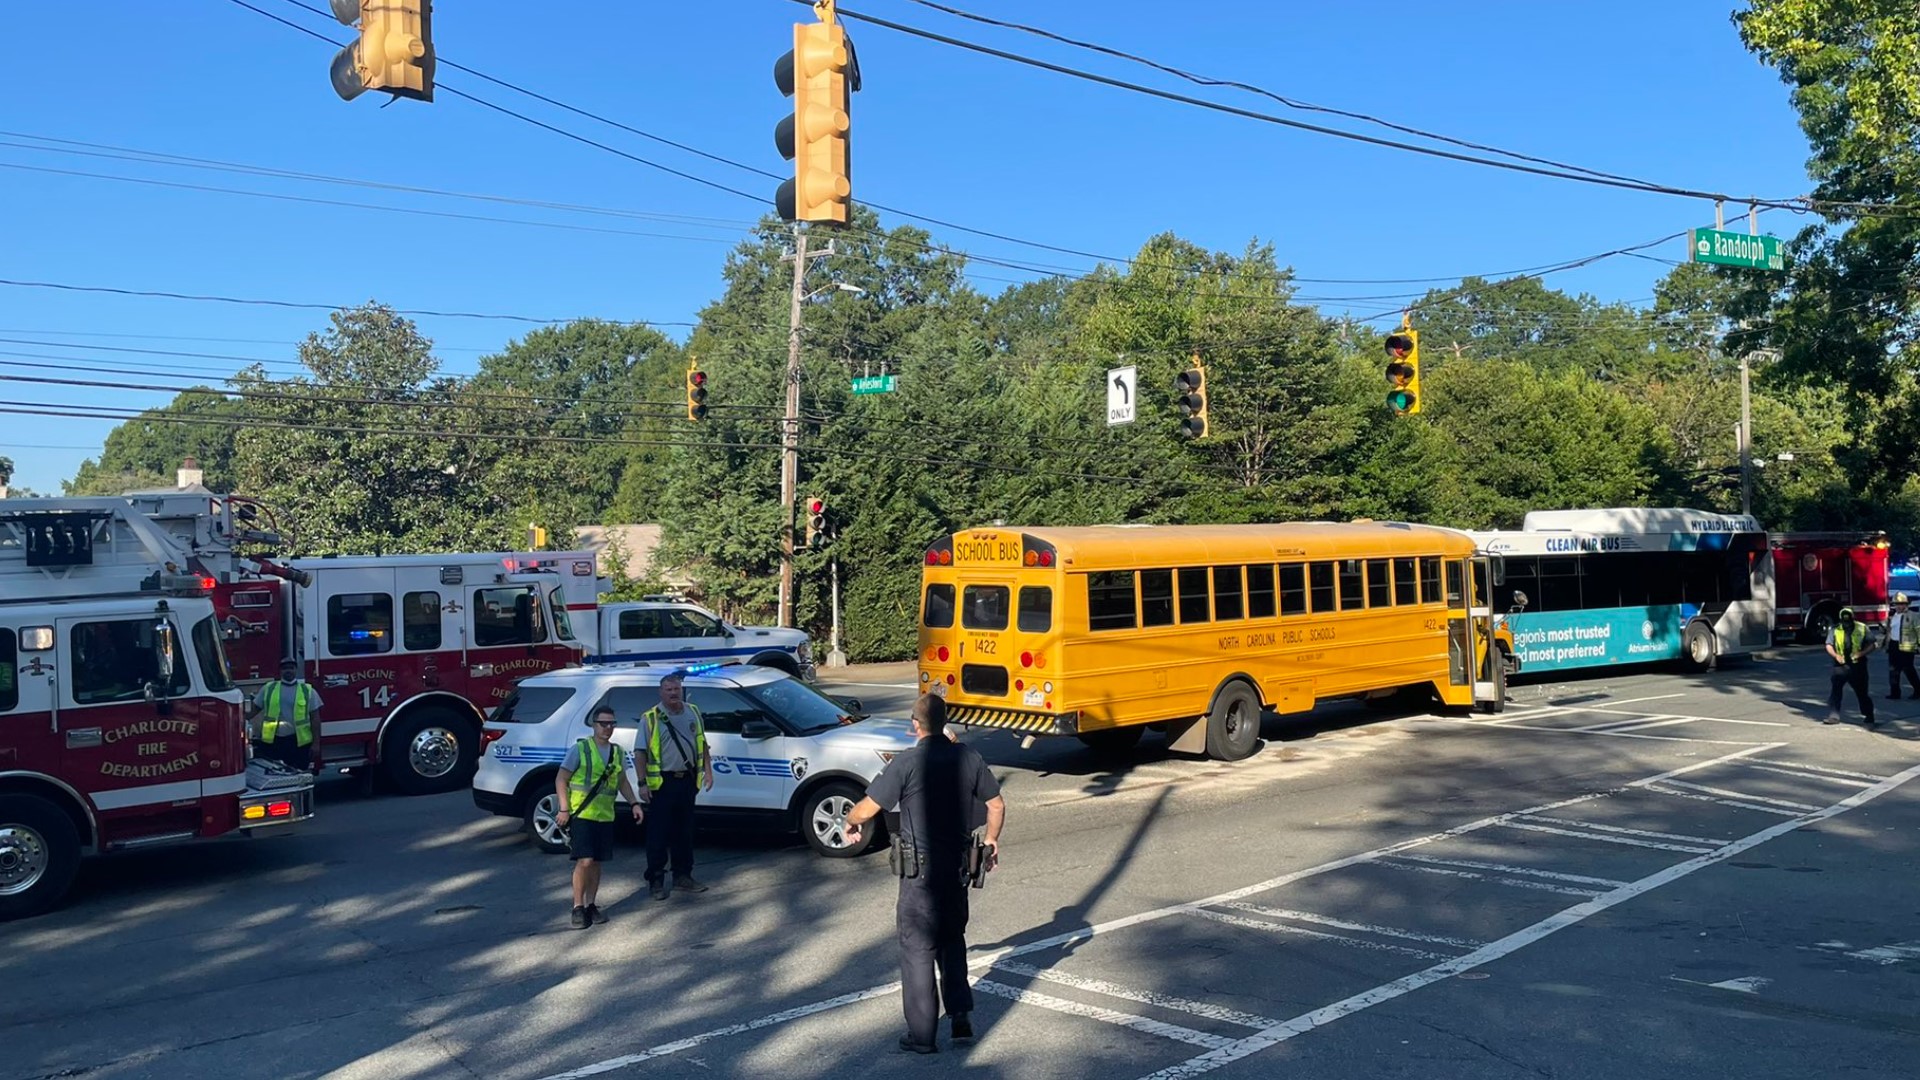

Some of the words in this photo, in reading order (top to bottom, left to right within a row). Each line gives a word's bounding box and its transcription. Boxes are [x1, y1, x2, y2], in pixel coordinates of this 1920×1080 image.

[1714, 233, 1765, 266] Randolph
[1111, 407, 1131, 420] ONLY
[1691, 520, 1721, 531] HYBRID
[1722, 520, 1754, 531] ELECTRIC
[956, 542, 995, 561] SCHOOL
[999, 542, 1019, 561] BUS
[1546, 538, 1578, 552] CLEAN
[1580, 537, 1598, 551] AIR
[1600, 537, 1620, 551] BUS
[1218, 635, 1240, 650] NORTH
[1246, 632, 1276, 648] CAROLINA
[1282, 629, 1304, 644] PUBLIC
[1310, 626, 1336, 642] SCHOOLS
[1514, 628, 1546, 647] egion's
[1547, 627, 1573, 642] most
[1575, 623, 1610, 640] trusted
[975, 639, 997, 655] 1422
[1529, 646, 1555, 661] most
[1557, 641, 1606, 663] preferred
[1628, 643, 1650, 653] Atrium
[350, 668, 396, 682] ENGINE
[494, 659, 552, 675] CHARLOTTE
[357, 684, 391, 708] 14
[104, 719, 198, 744] CHARLOTTE
[138, 741, 168, 756] FIRE
[100, 751, 200, 778] DEPARTMENT
